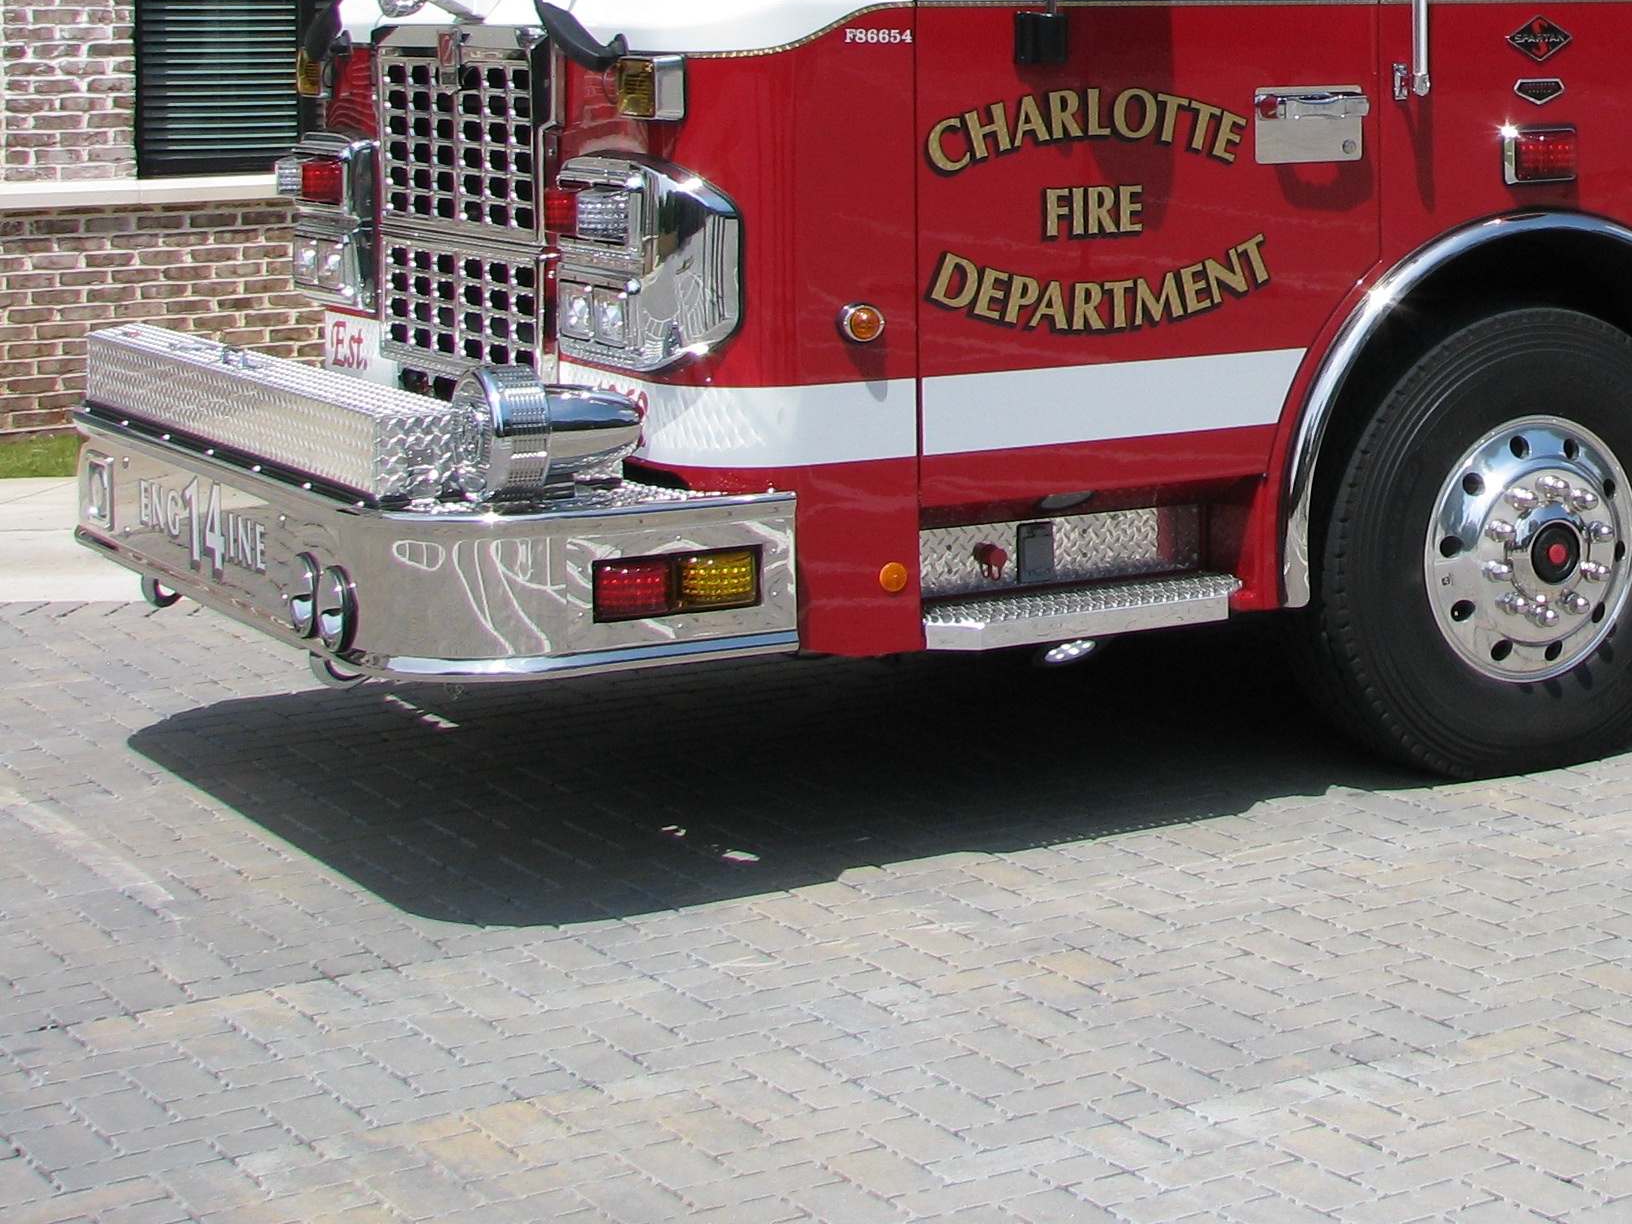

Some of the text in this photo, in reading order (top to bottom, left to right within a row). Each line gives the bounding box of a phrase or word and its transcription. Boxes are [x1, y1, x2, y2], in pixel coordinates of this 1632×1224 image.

[844, 28, 913, 44] F86654
[925, 88, 1248, 174] CHARLOTTE
[1045, 184, 1143, 238] FIRE
[929, 233, 1271, 332] DEPARTMENT
[330, 320, 368, 371] Est.
[182, 476, 225, 578] 14
